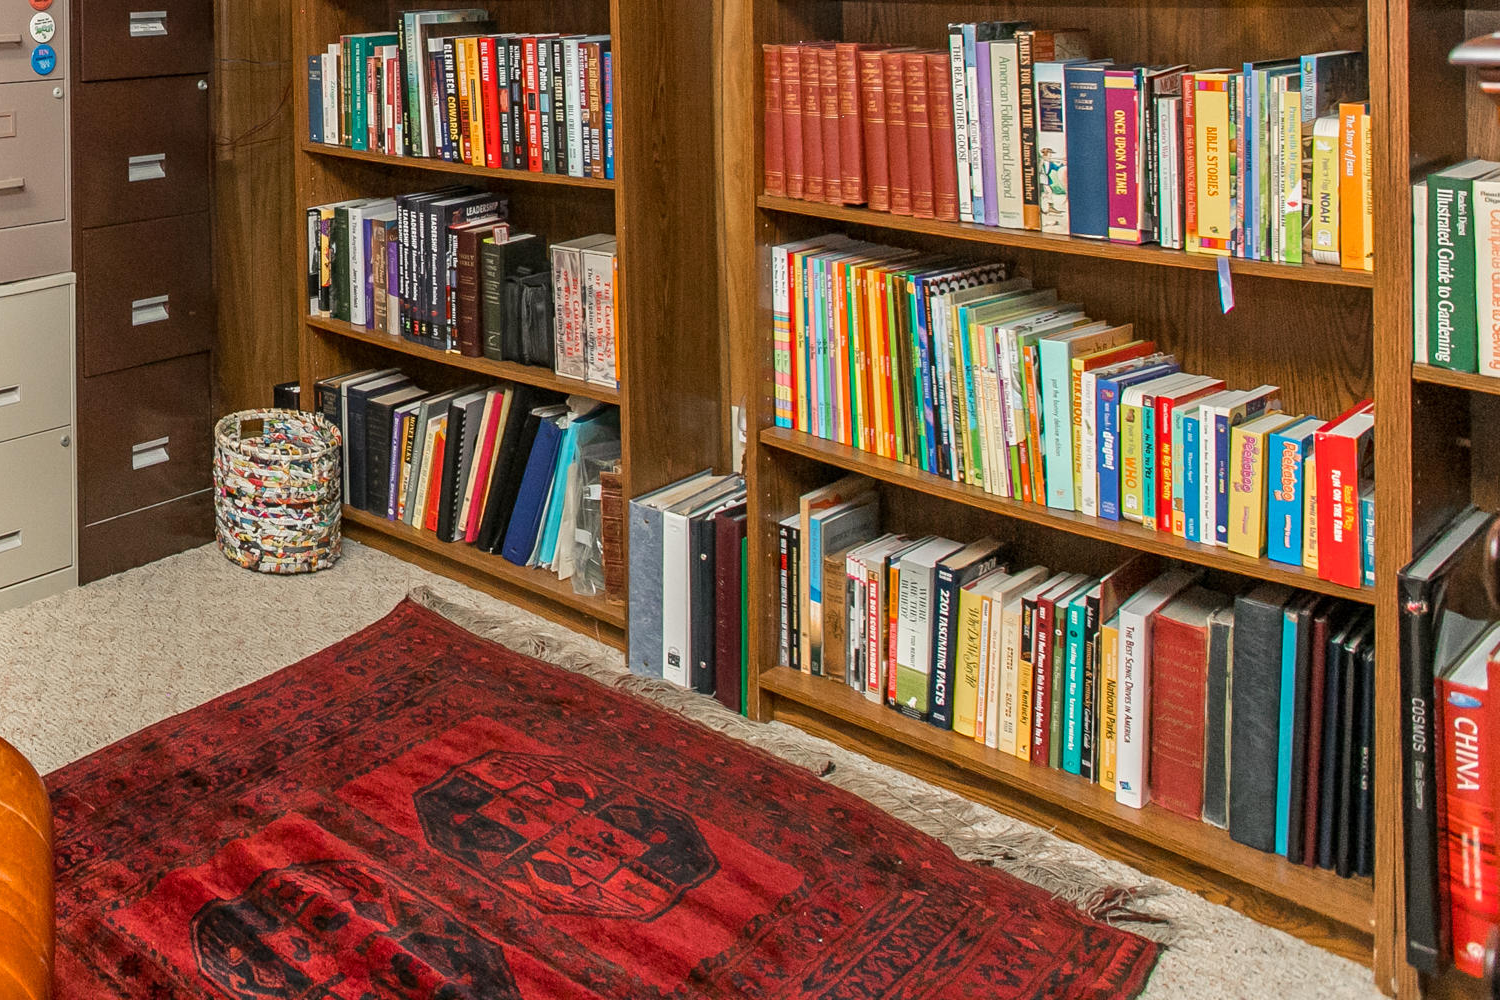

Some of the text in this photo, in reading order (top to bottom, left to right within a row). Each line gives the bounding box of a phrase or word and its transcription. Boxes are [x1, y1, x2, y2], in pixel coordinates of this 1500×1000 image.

[480, 41, 489, 81] BILL O'REILLY
[537, 43, 547, 65] Killing
[1020, 34, 1031, 66] FABLES
[443, 44, 458, 140] GLENN BECK COWARDS
[539, 67, 548, 90] Patton
[554, 75, 563, 101] LEGENDS
[1021, 68, 1032, 84] FOR
[953, 45, 967, 163] THE REAL MOTHER GOOSE
[1022, 88, 1033, 105] OUR
[999, 56, 1015, 198] American Folklore and Legend
[1022, 108, 1033, 128] TIME
[1114, 109, 1127, 134] ONCE
[1346, 115, 1355, 127] The
[1022, 140, 1033, 165] James
[1114, 136, 1127, 161] UPON
[1345, 129, 1355, 148] Story
[1206, 126, 1219, 197] BIBLE STORIES
[1345, 157, 1355, 177] Jesus
[1024, 166, 1034, 200] Thurber
[1116, 172, 1127, 194] TIME
[1320, 192, 1330, 223] NOAH
[402, 209, 410, 247] LEADERSHIP
[1457, 217, 1467, 235] Digest
[1435, 189, 1454, 362] Illustrated Guide to Gardening
[1052, 400, 1060, 416] bunny
[1125, 456, 1137, 488] WHO
[1331, 469, 1343, 542] FUN ON THE FARM
[901, 580, 909, 619] BURIED?
[909, 578, 918, 624] ARE THEY
[919, 588, 927, 623] WHERE
[935, 588, 950, 705] 2201 FASCINATING FACTS
[1123, 626, 1134, 743] THE BEST SCENIC DRIVES IN AMERICA
[1020, 689, 1030, 725] Kentucky
[1105, 678, 1116, 739] National Parks
[1411, 697, 1426, 752] COSMOS
[1454, 716, 1480, 790] CHINA
